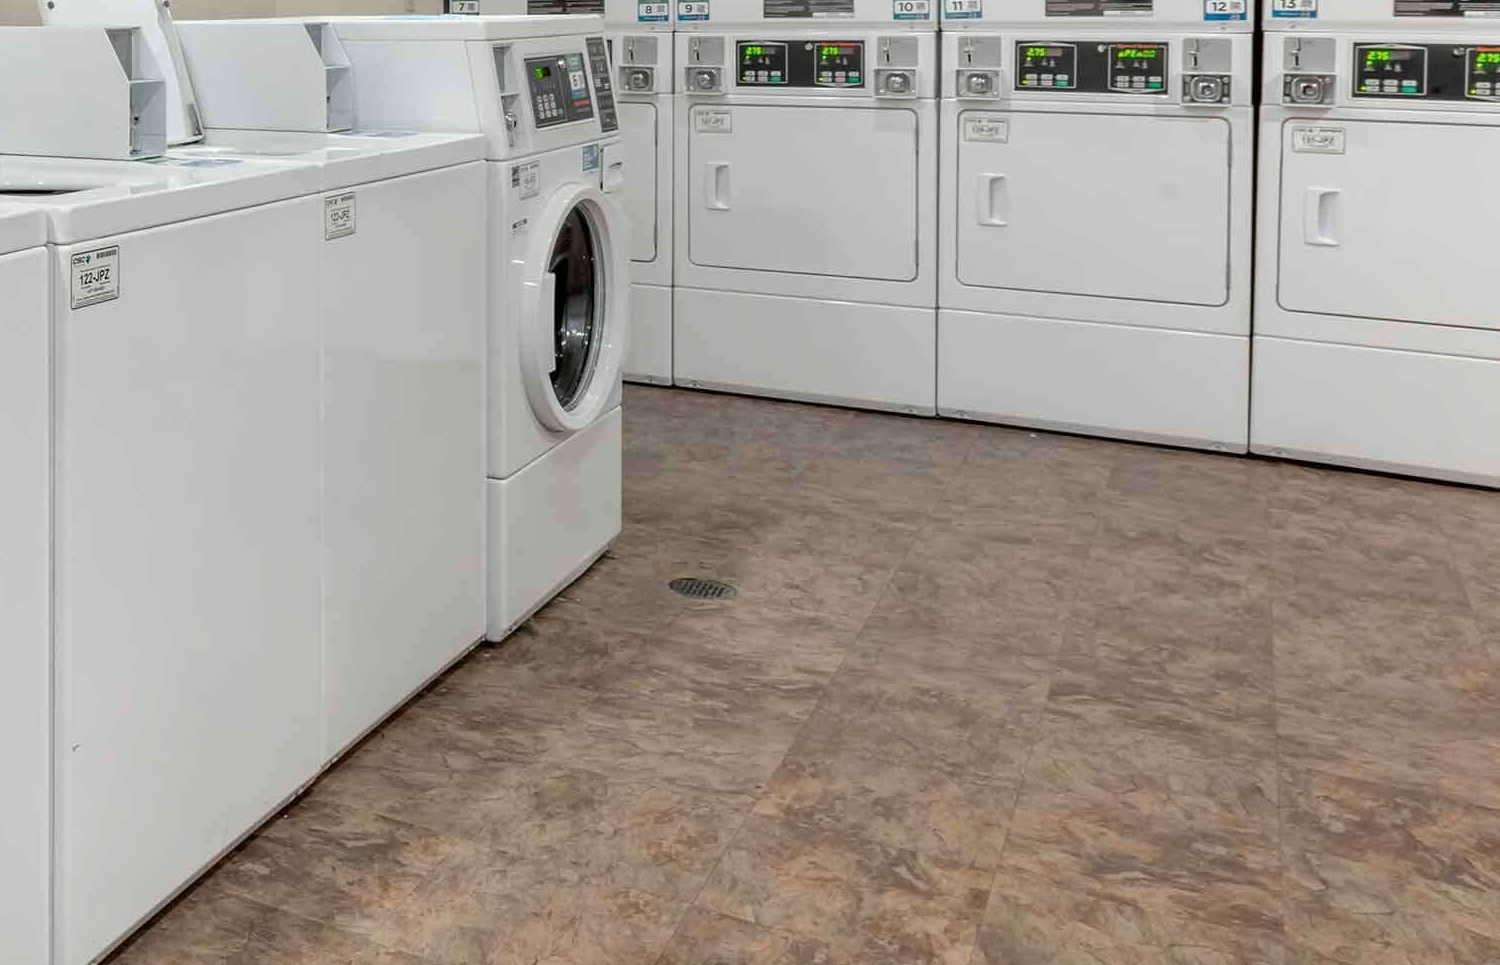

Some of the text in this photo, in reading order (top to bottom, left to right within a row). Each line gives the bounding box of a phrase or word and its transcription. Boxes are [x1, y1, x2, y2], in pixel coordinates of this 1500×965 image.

[645, 5, 653, 14] 8
[685, 3, 693, 13] 9
[899, 2, 914, 12] 10
[952, 1, 963, 11] 11
[1211, 1, 1227, 12] 12
[80, 267, 110, 286] 122-JPZ
